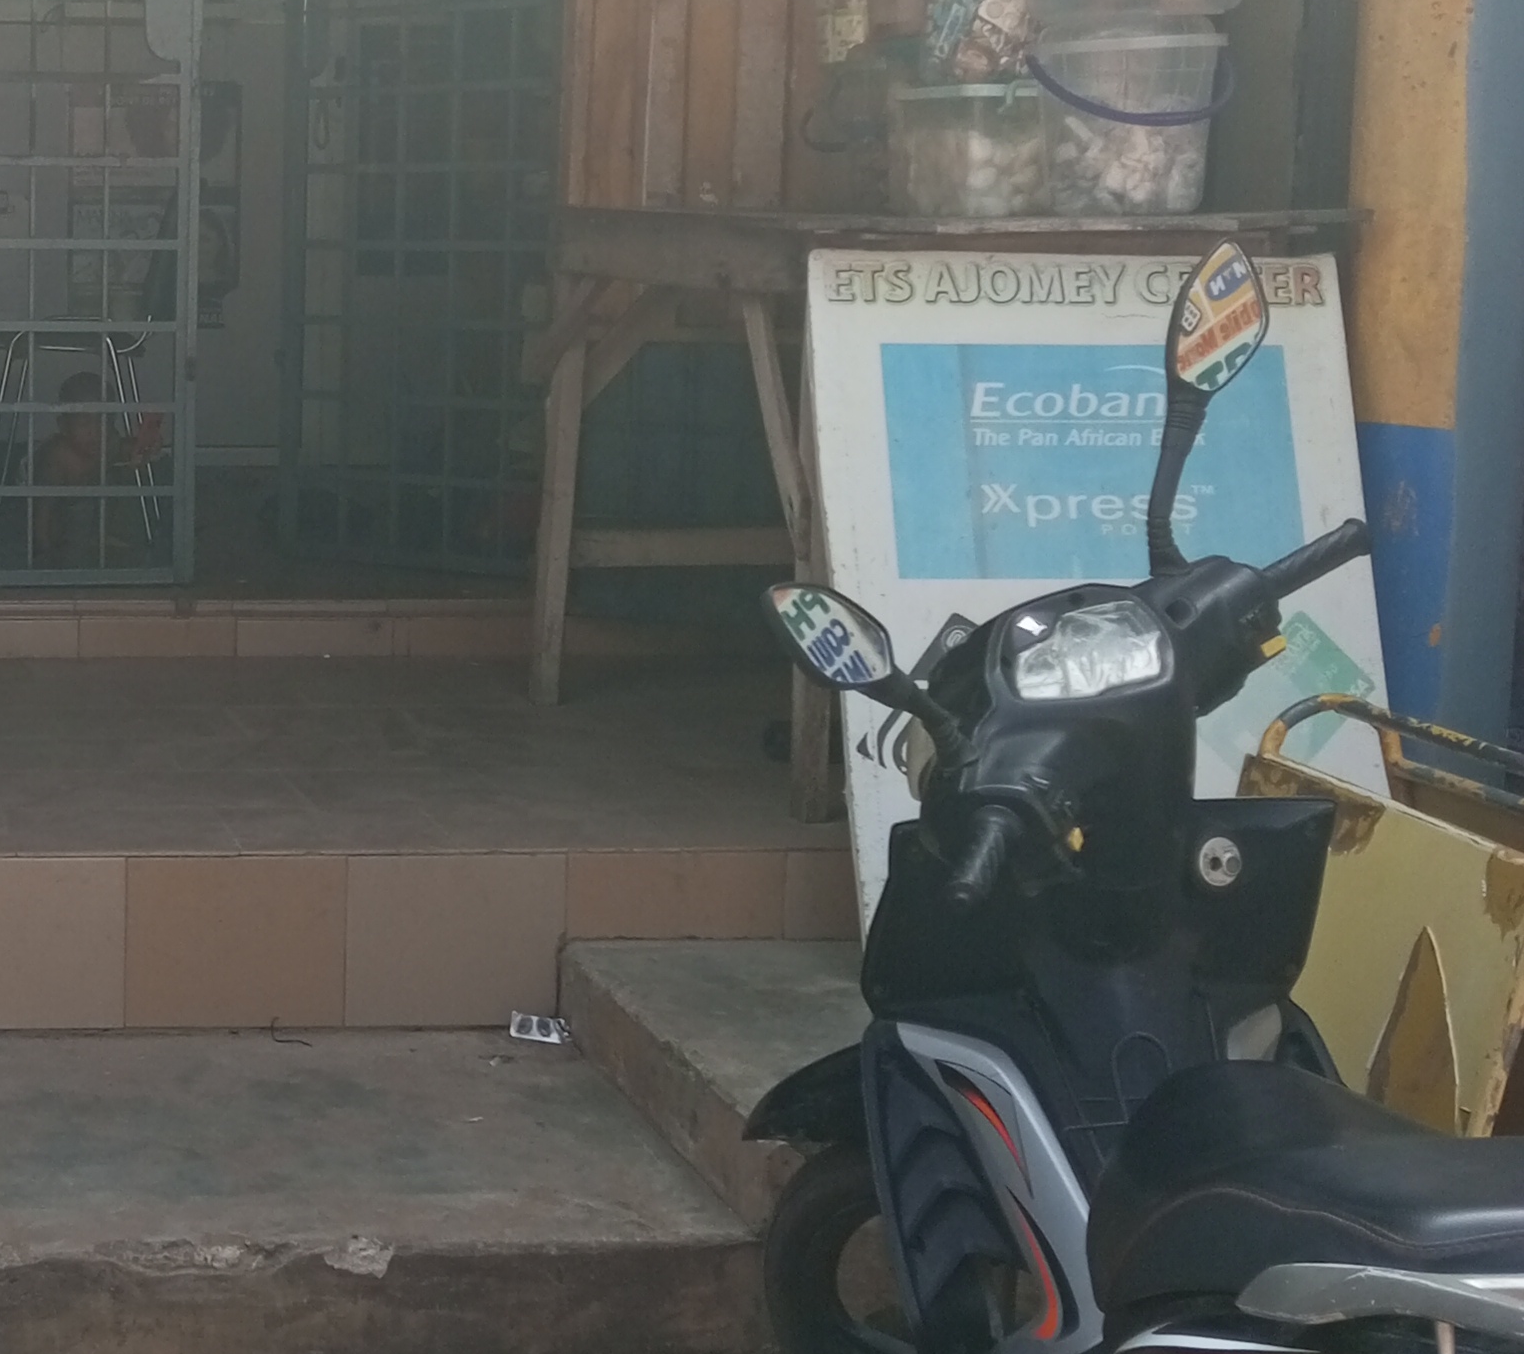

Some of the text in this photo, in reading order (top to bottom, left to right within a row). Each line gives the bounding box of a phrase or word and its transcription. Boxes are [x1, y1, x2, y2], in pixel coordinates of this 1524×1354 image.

[826, 261, 1326, 307] ETS AJOMEY CEER
[970, 382, 1167, 418] Ecoban
[973, 428, 1142, 446] The Pan African
[1101, 524, 1194, 536] POT
